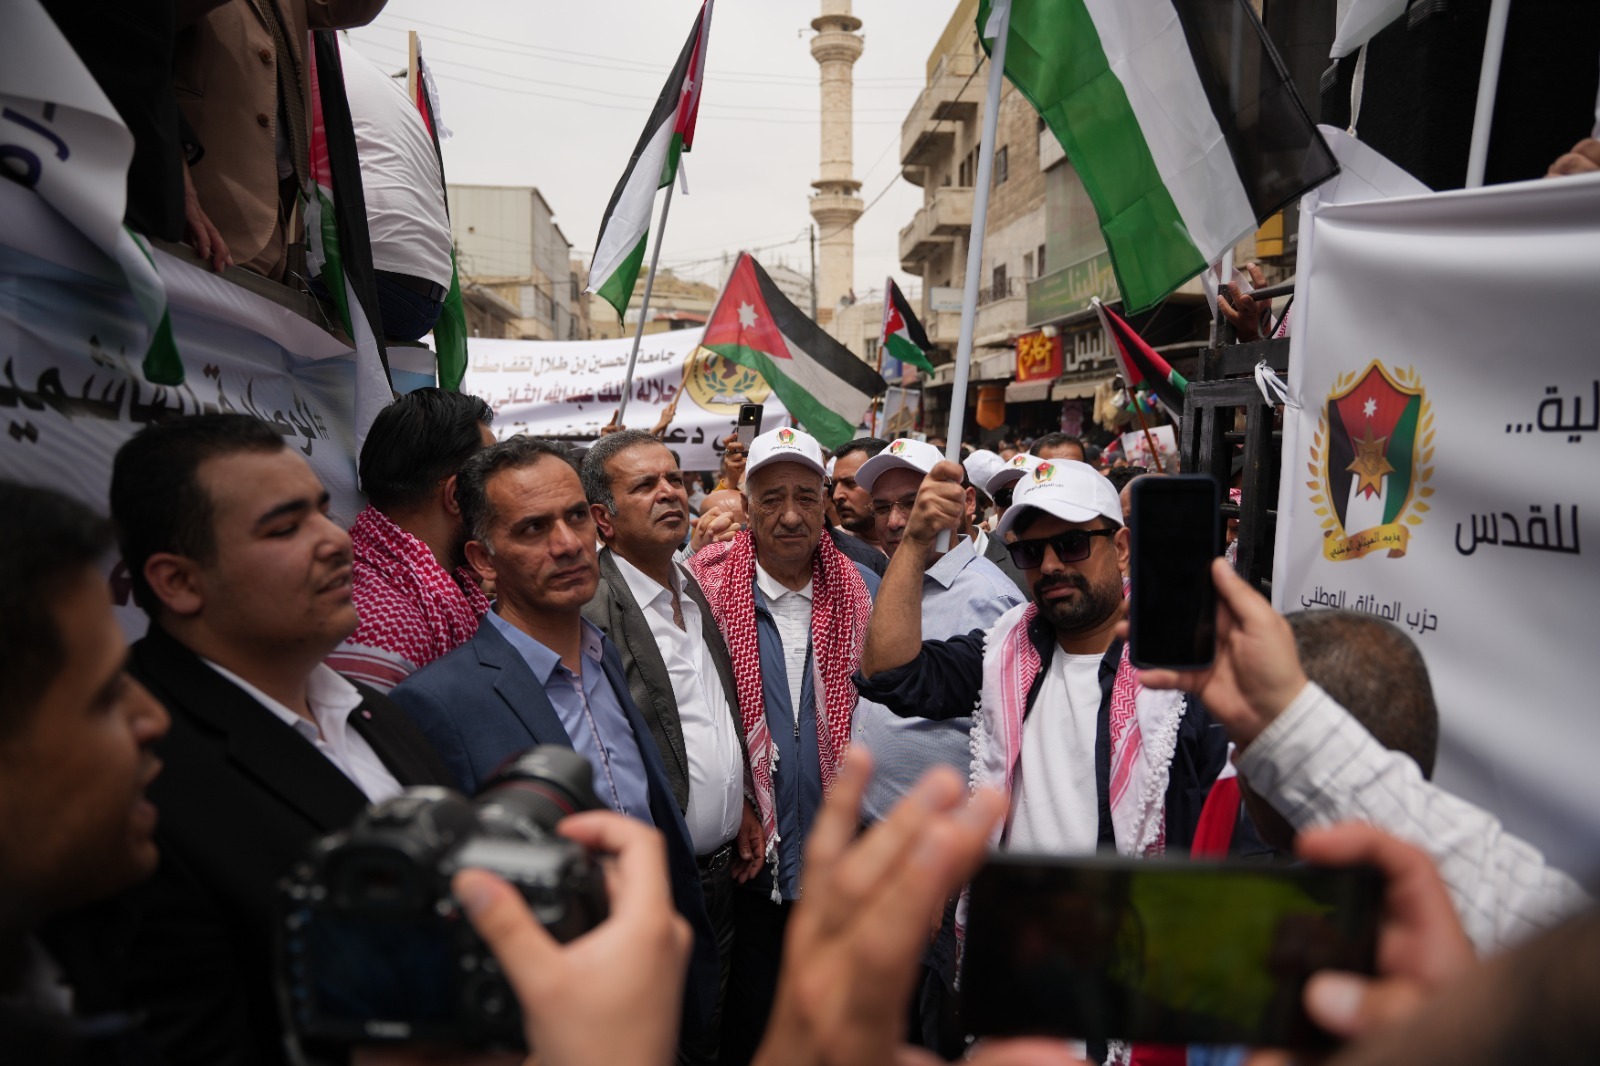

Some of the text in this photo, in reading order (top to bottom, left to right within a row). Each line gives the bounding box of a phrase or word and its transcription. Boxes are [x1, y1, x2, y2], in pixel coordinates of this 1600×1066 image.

[533, 355, 568, 377] طلال
[570, 356, 586, 375] بن
[588, 352, 629, 374] لحسين
[637, 347, 676, 365] جامعة
[662, 427, 704, 444] دع
[1456, 504, 1580, 556] للقدس
[1301, 586, 1346, 611] الوطني
[1406, 608, 1438, 634] حزب
